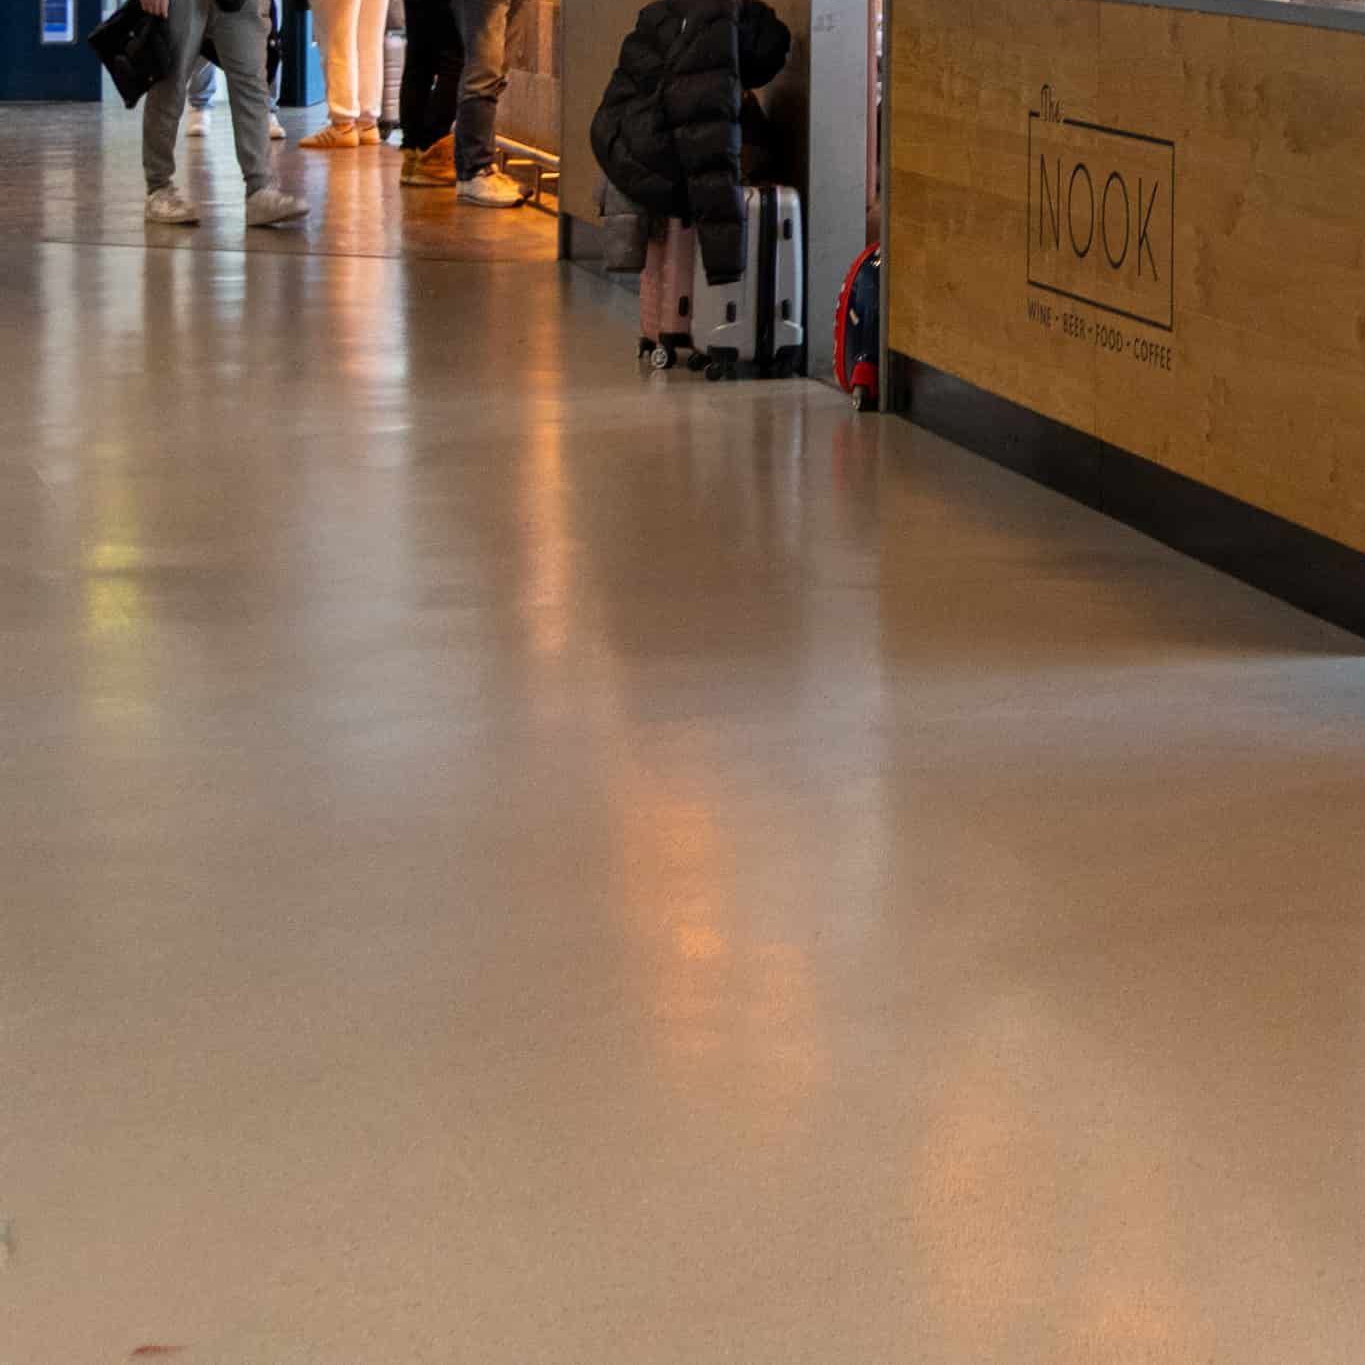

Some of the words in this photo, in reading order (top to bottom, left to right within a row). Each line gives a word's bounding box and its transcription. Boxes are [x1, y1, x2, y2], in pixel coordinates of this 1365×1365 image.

[1040, 84, 1064, 123] The
[1039, 153, 1159, 282] NOOK
[1027, 297, 1052, 327] WINE
[1063, 313, 1087, 339] BEER
[1095, 323, 1124, 353] FOOD
[1134, 337, 1172, 371] COFFEE
